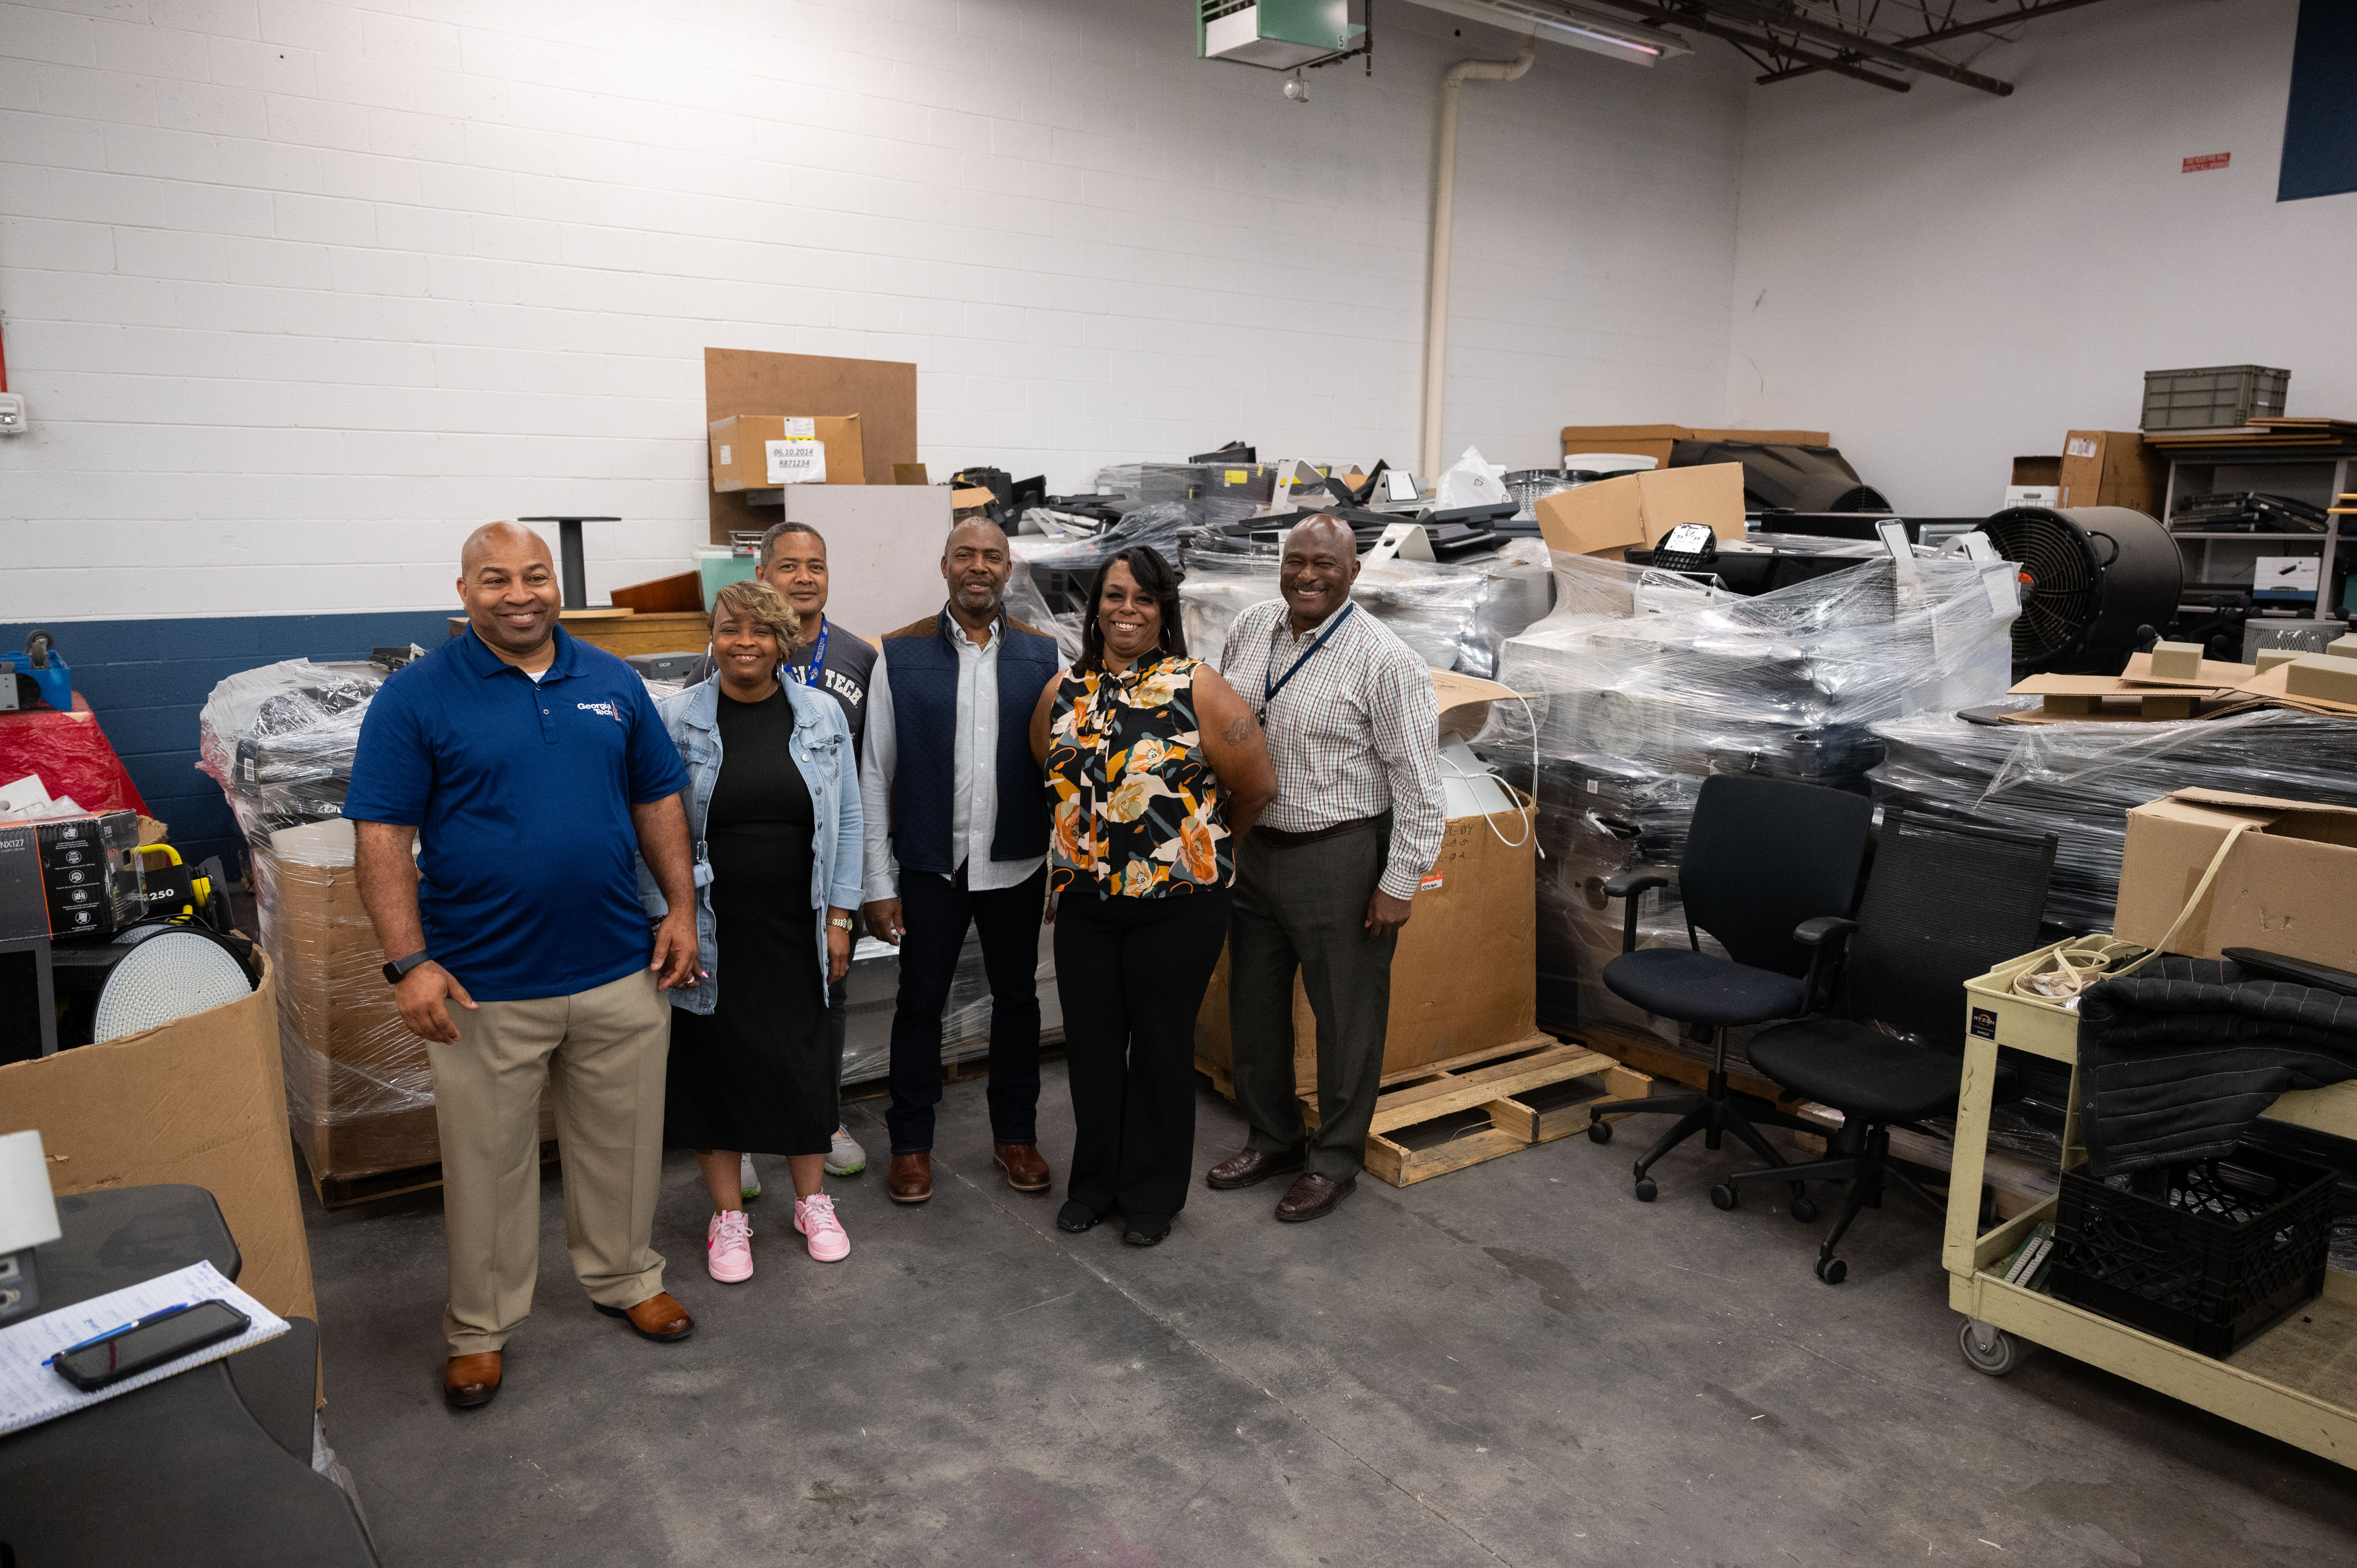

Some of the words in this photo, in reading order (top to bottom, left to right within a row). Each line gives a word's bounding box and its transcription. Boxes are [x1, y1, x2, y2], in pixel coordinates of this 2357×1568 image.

[1339, 35, 1344, 47] 5
[825, 669, 863, 706] TECH
[577, 702, 612, 710] Georgia
[0, 839, 24, 849] NX127
[149, 888, 174, 901] 250
[1974, 1015, 1995, 1025] RYZEN
